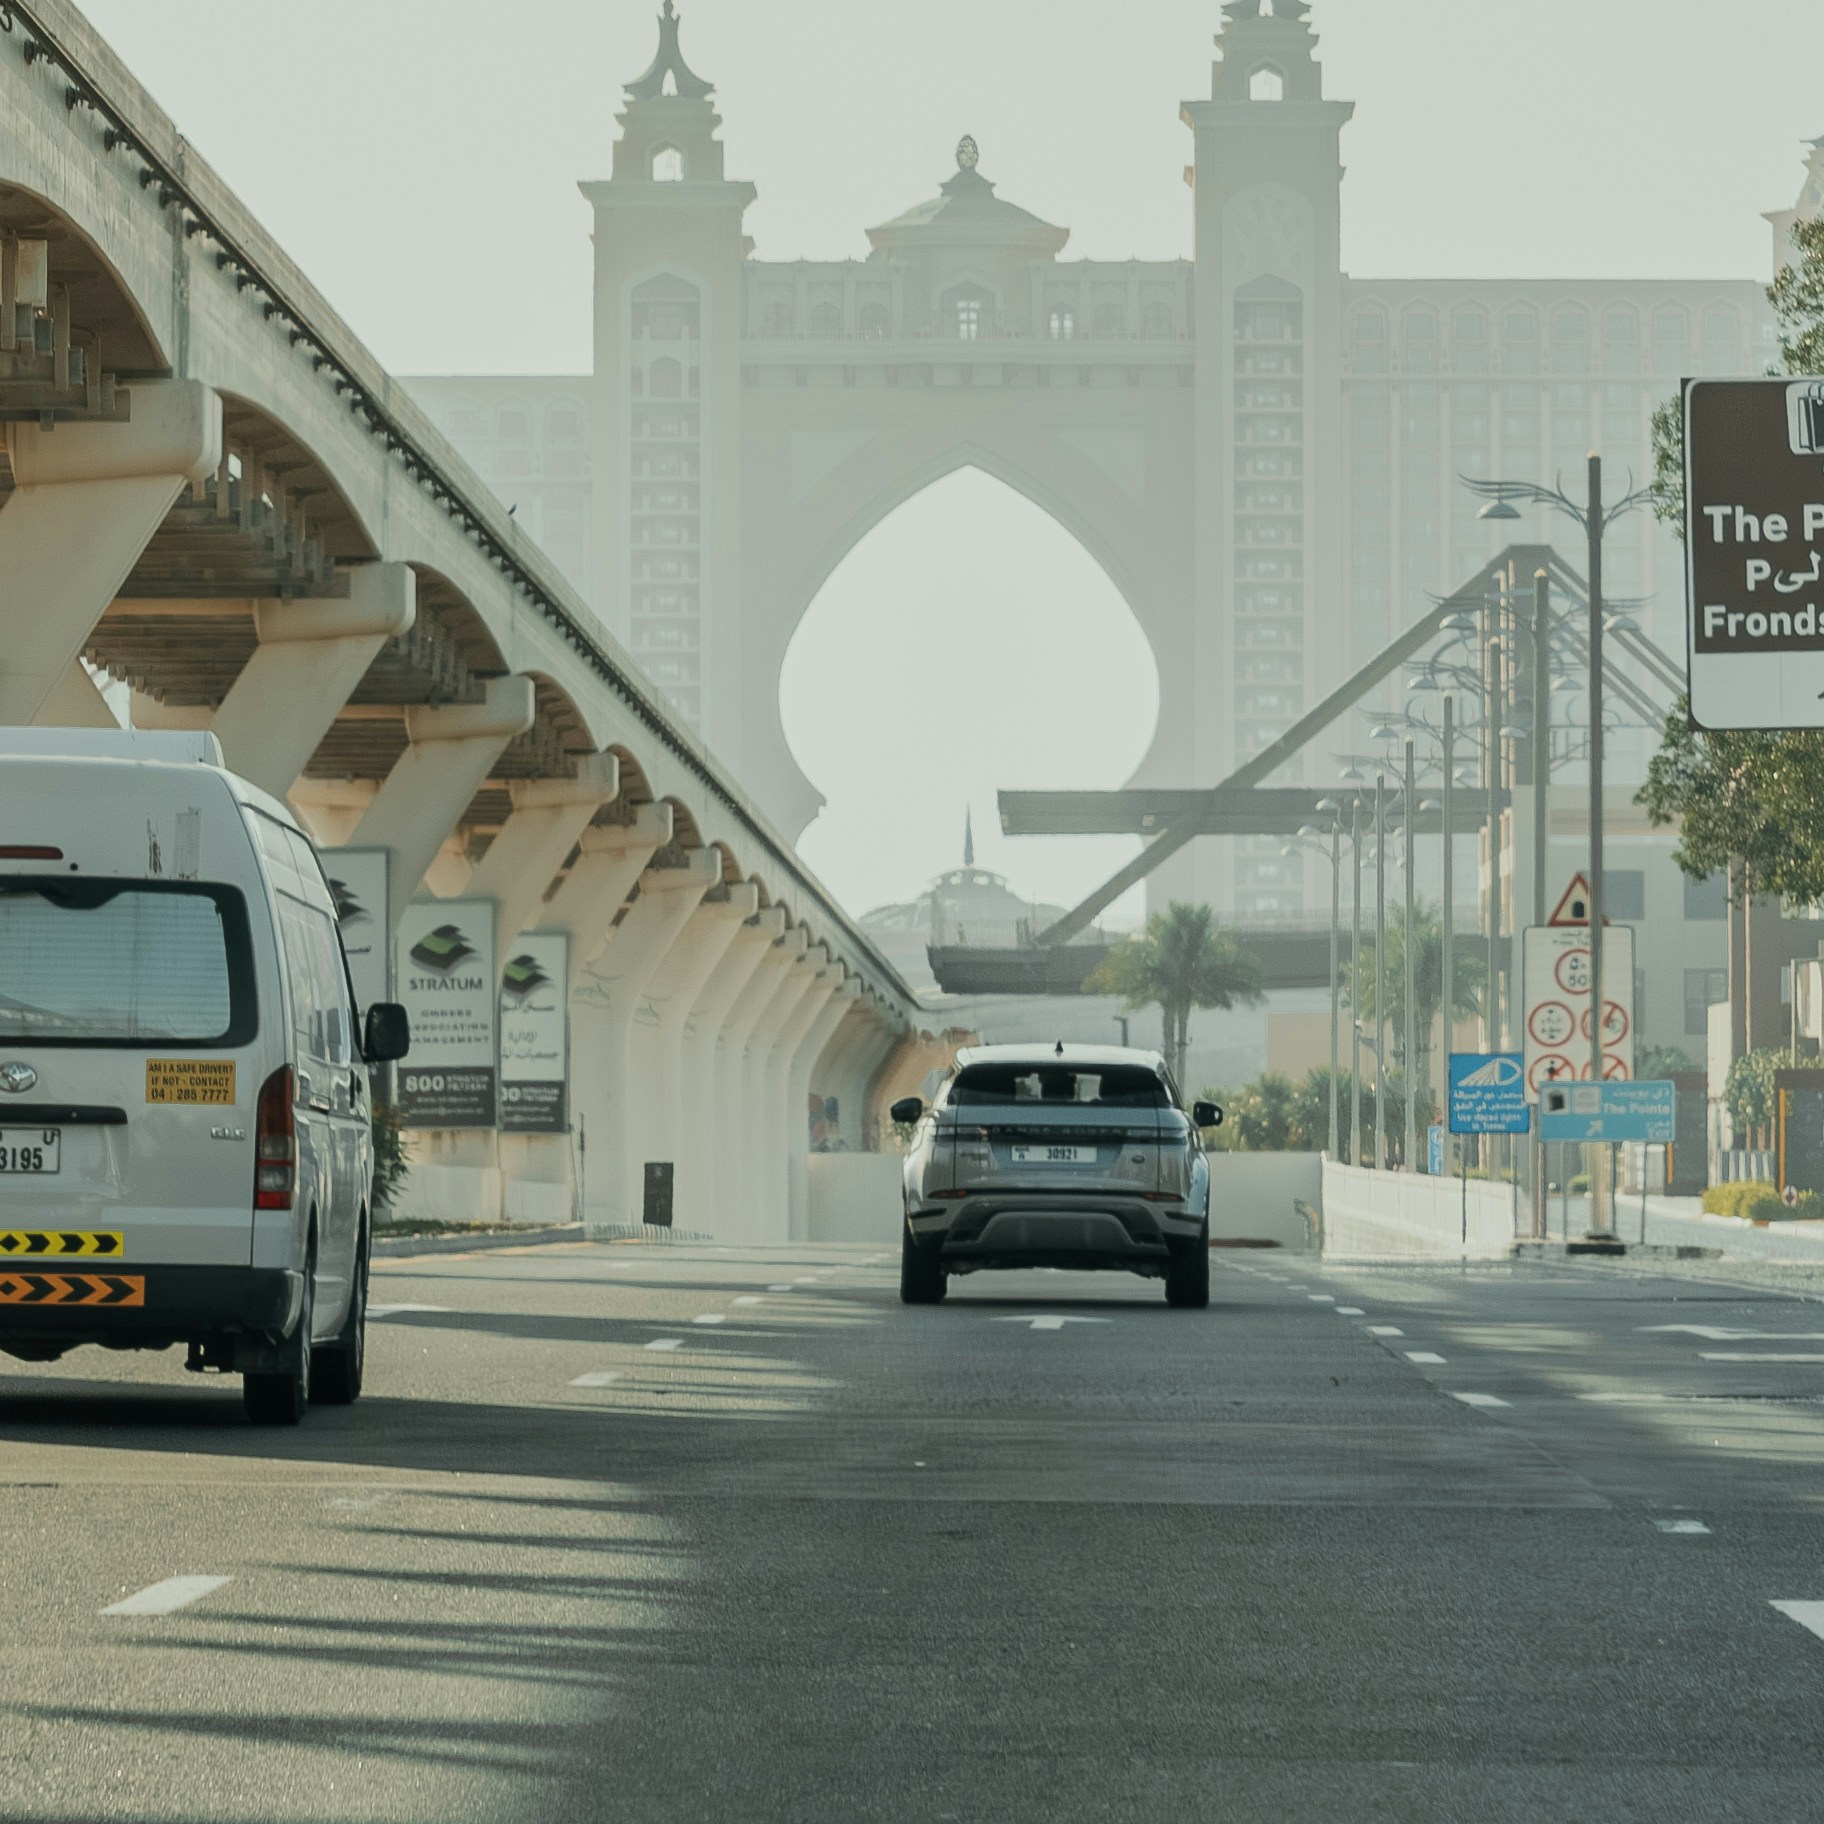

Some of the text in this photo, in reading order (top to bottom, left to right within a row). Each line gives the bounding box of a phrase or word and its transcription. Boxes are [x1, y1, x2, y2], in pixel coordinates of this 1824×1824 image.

[1703, 505, 1788, 544] The
[409, 977, 484, 991] STRATUM
[177, 1064, 196, 1074] SAFE
[162, 1076, 179, 1086] NOT
[189, 1077, 229, 1087] CONTACT
[405, 1075, 445, 1093] 800
